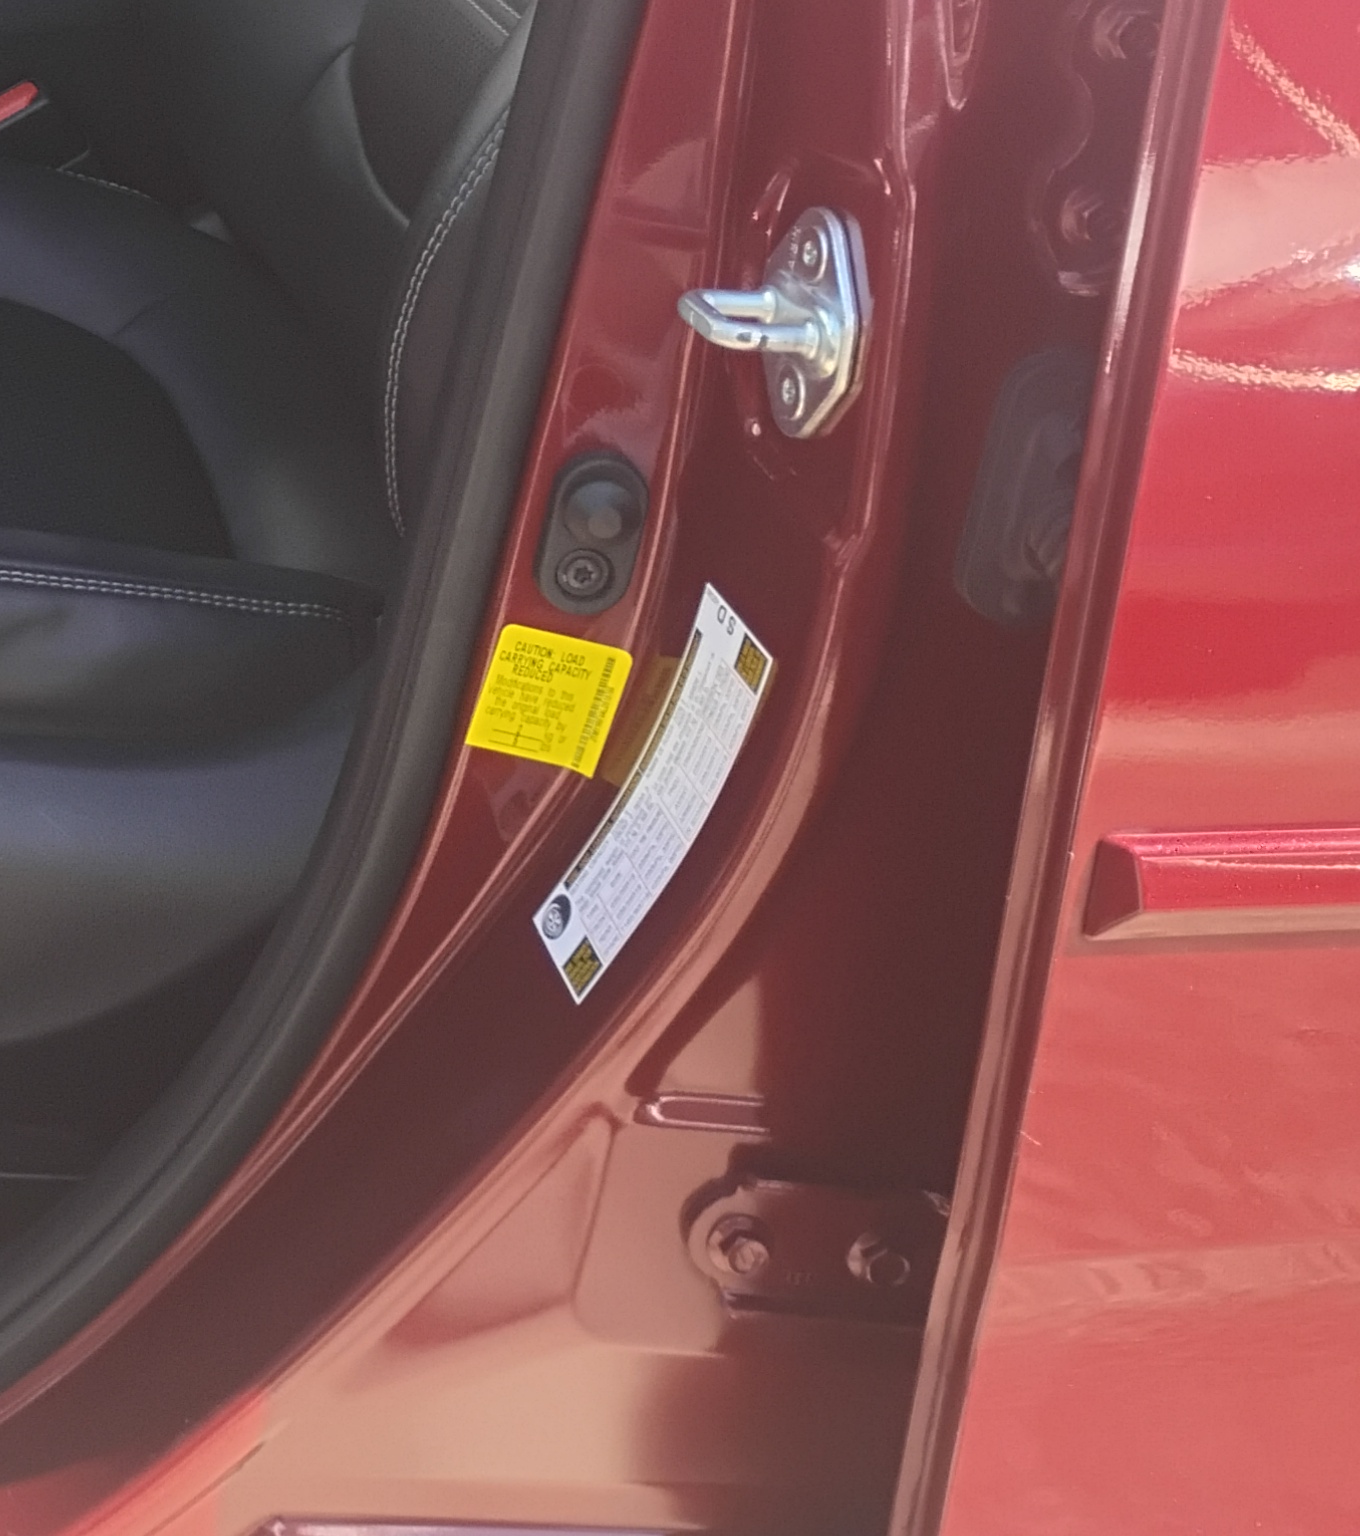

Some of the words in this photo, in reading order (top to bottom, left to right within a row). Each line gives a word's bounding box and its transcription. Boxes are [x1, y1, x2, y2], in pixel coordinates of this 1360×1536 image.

[499, 650, 544, 670] CARRYING
[548, 661, 592, 680] CAPACITY
[514, 641, 555, 659] CAUTION:
[561, 652, 586, 666] LOAD
[512, 664, 554, 683] REDUCED
